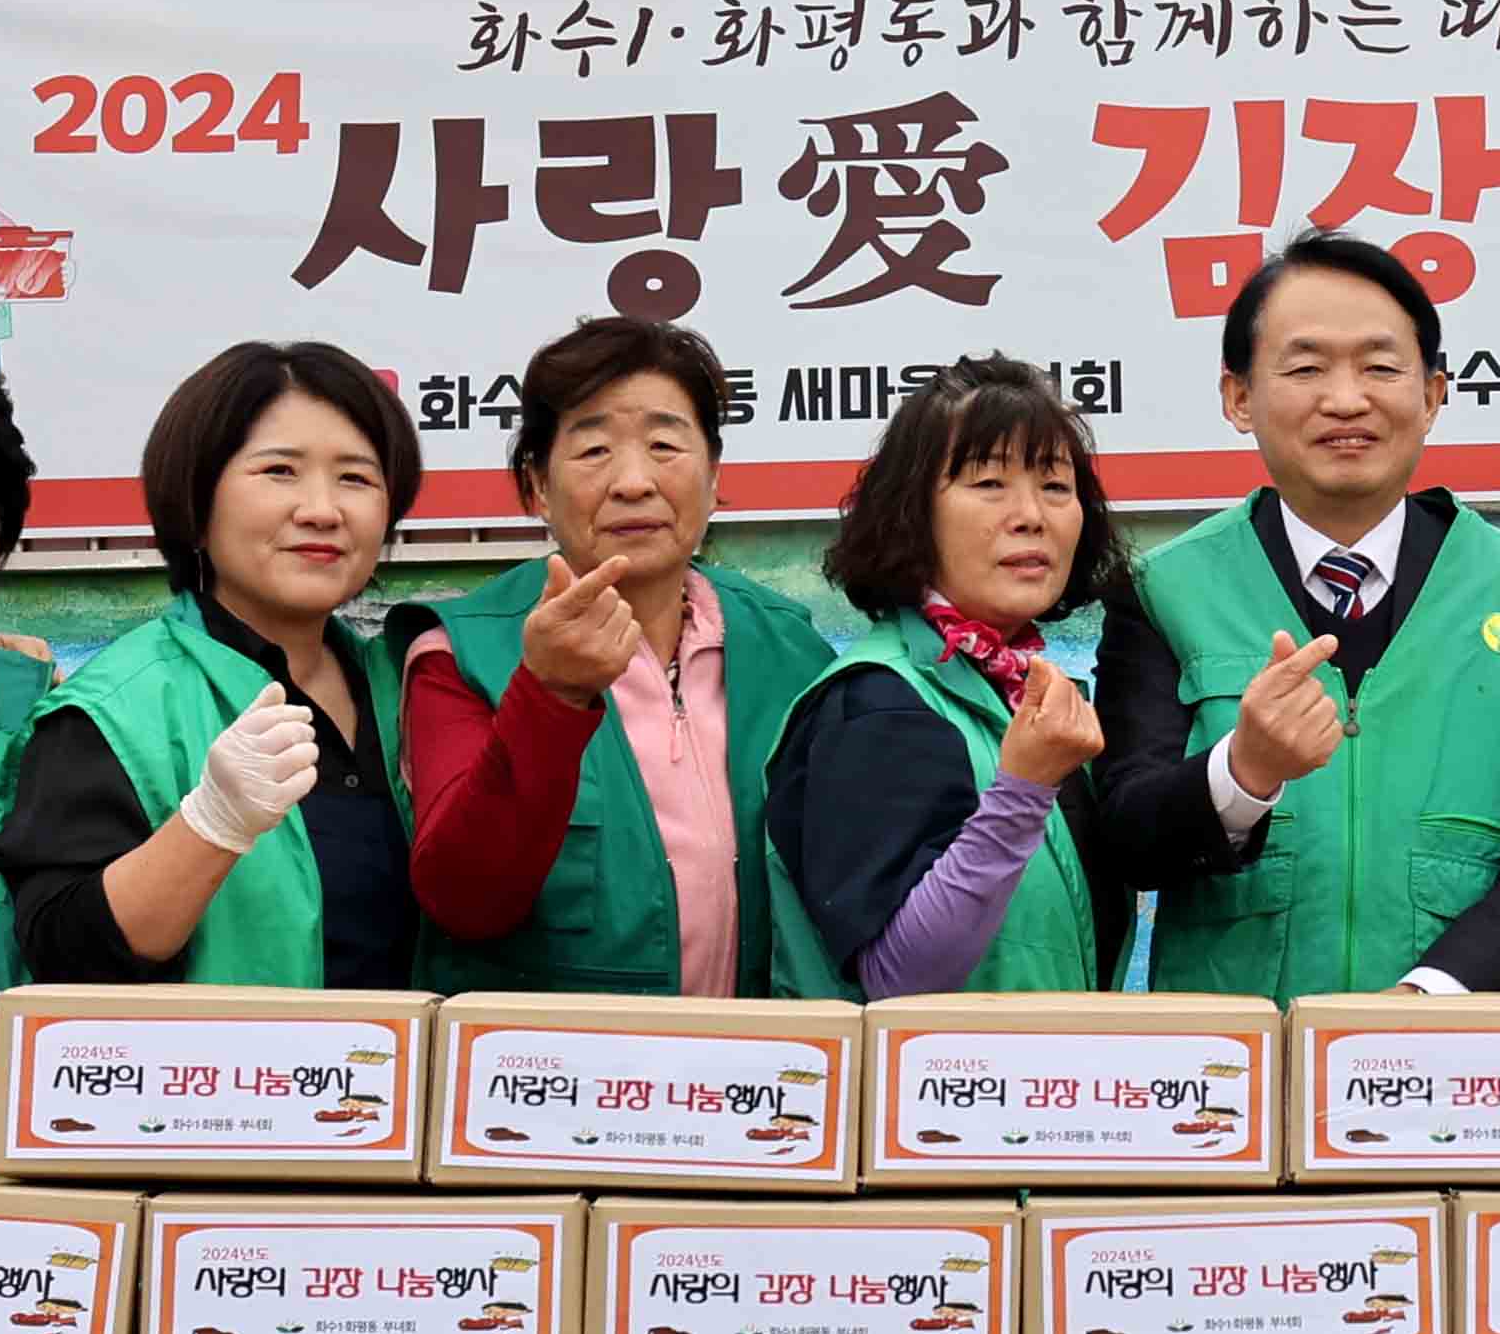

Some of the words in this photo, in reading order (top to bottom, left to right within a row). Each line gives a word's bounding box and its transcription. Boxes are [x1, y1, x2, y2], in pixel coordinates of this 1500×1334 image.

[34, 72, 309, 154] 2024
[60, 1044, 130, 1060] 2024년도
[924, 1057, 992, 1073] 2024년도
[52, 1064, 144, 1095] 사랑의
[160, 1066, 220, 1096] 김장
[917, 1076, 1007, 1107] 사랑의
[1022, 1079, 1081, 1108] 김장
[1089, 1247, 1159, 1265] 2024년도
[1083, 1266, 1175, 1300] 사랑의
[1188, 1265, 1249, 1297] 김장
